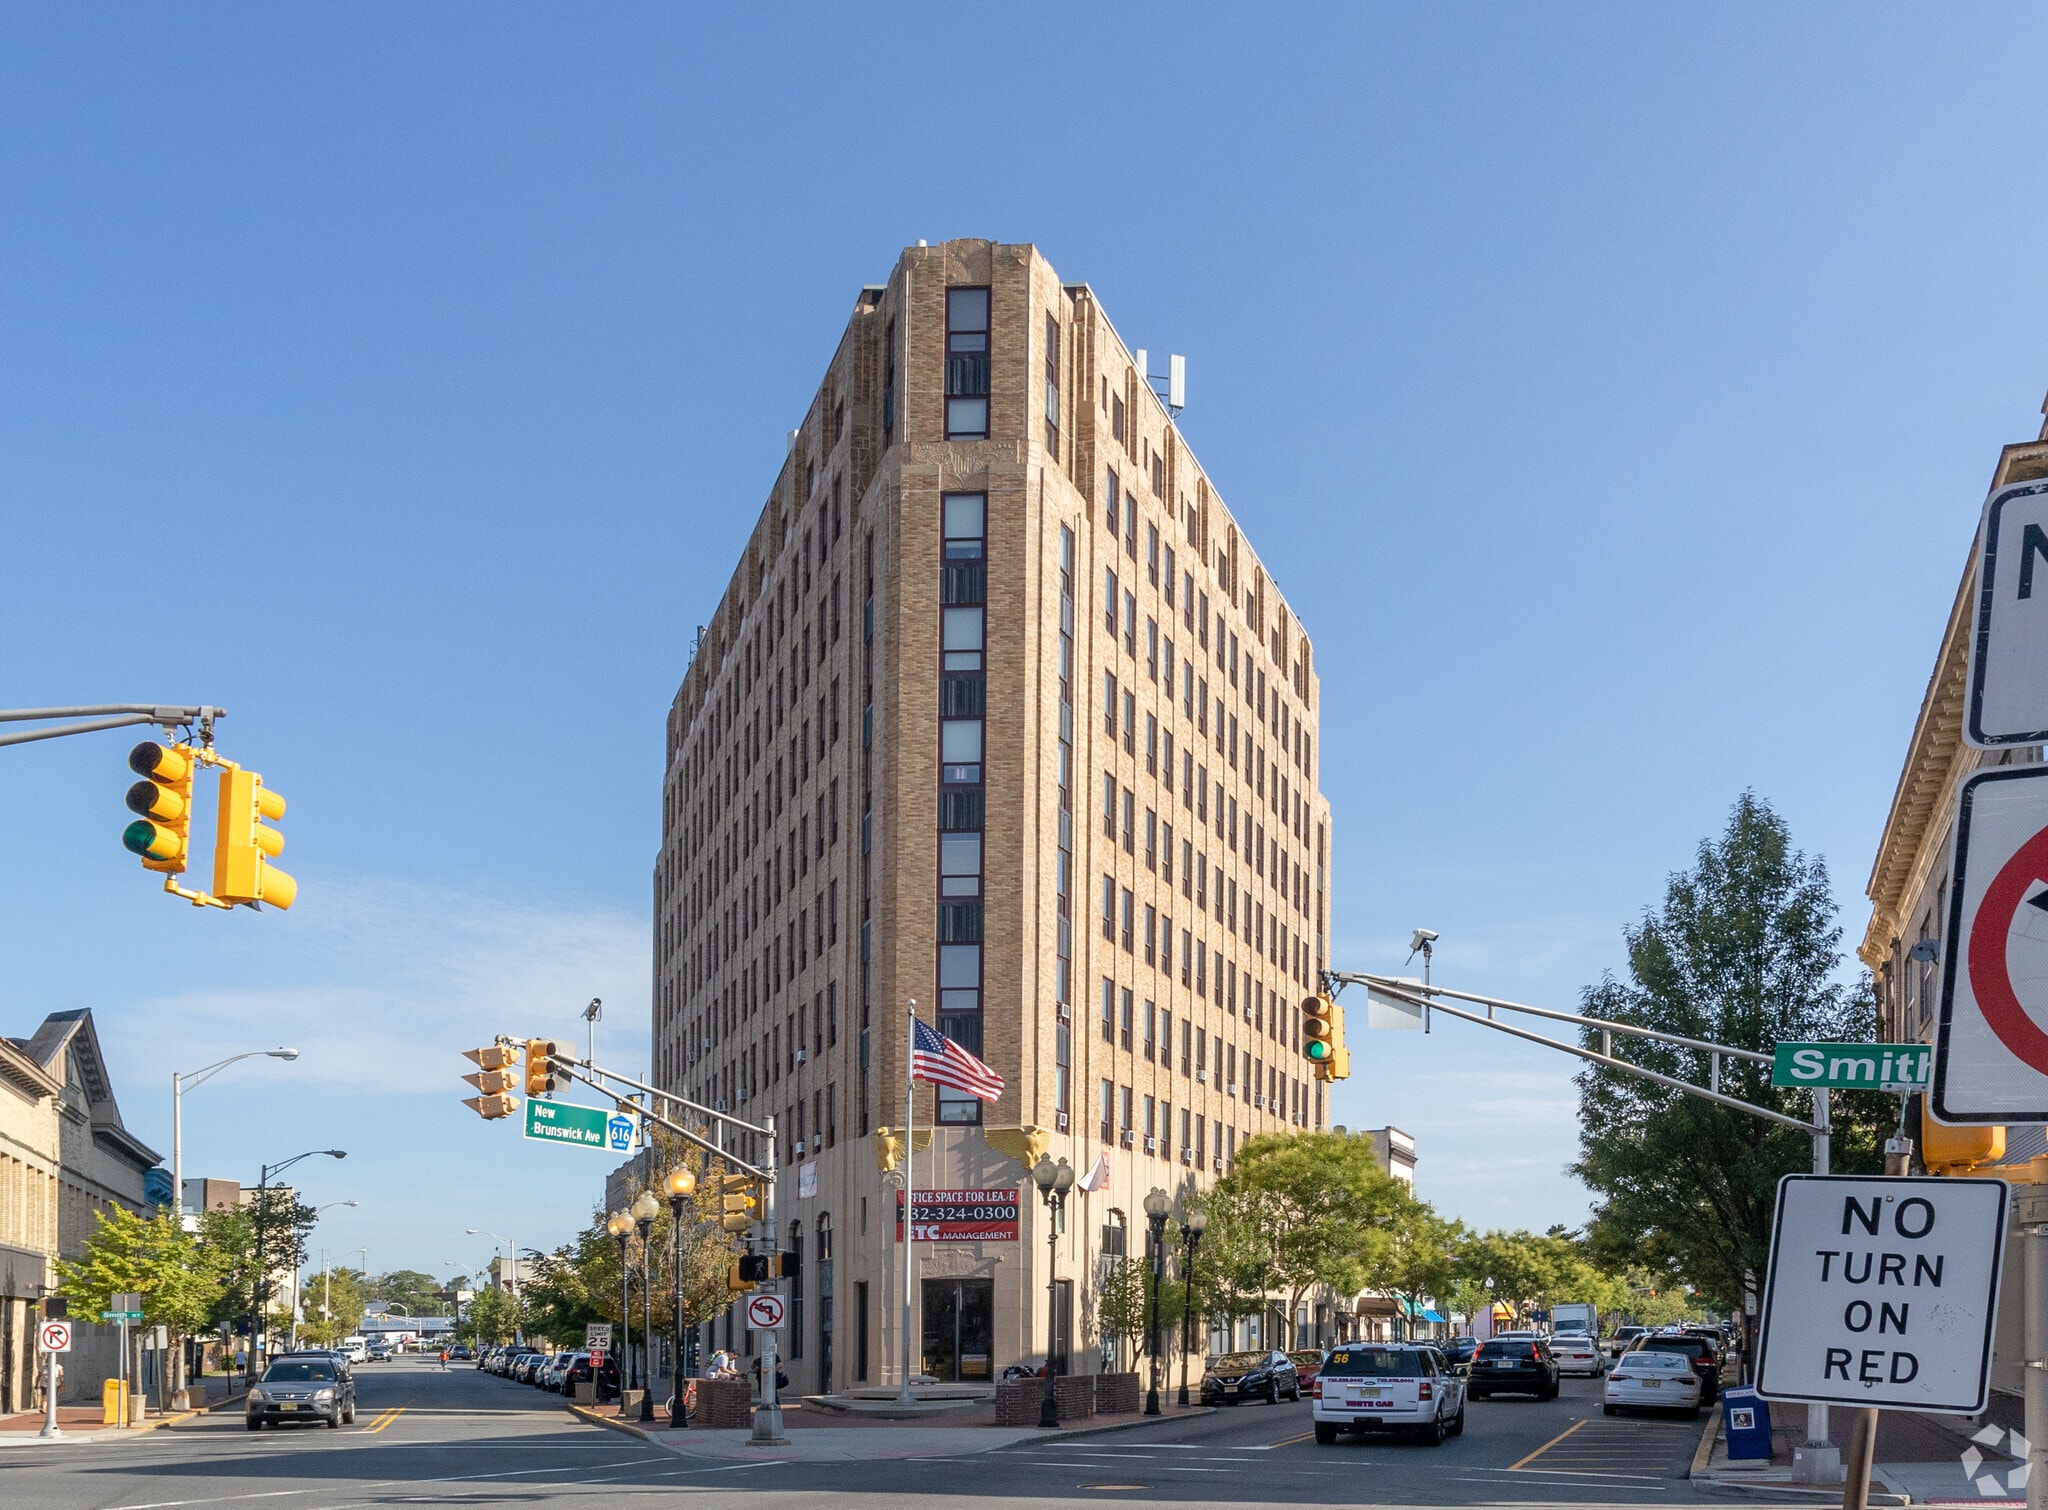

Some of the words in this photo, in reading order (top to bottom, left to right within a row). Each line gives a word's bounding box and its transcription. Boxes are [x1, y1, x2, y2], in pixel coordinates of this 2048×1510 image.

[533, 1104, 556, 1119] New
[533, 1121, 583, 1140] Brunswick
[585, 1128, 601, 1143] Ave
[611, 1127, 630, 1142] 616
[935, 1191, 964, 1202] SPACE
[965, 1191, 985, 1202] FOR
[1841, 1195, 1936, 1239] NO
[942, 1231, 1013, 1239] MANAGEMENT
[1815, 1250, 1944, 1288] TURN
[1844, 1300, 1910, 1335] ON
[588, 1337, 608, 1347] 25
[1333, 1353, 1349, 1364] 56
[1823, 1347, 1919, 1384] RED
